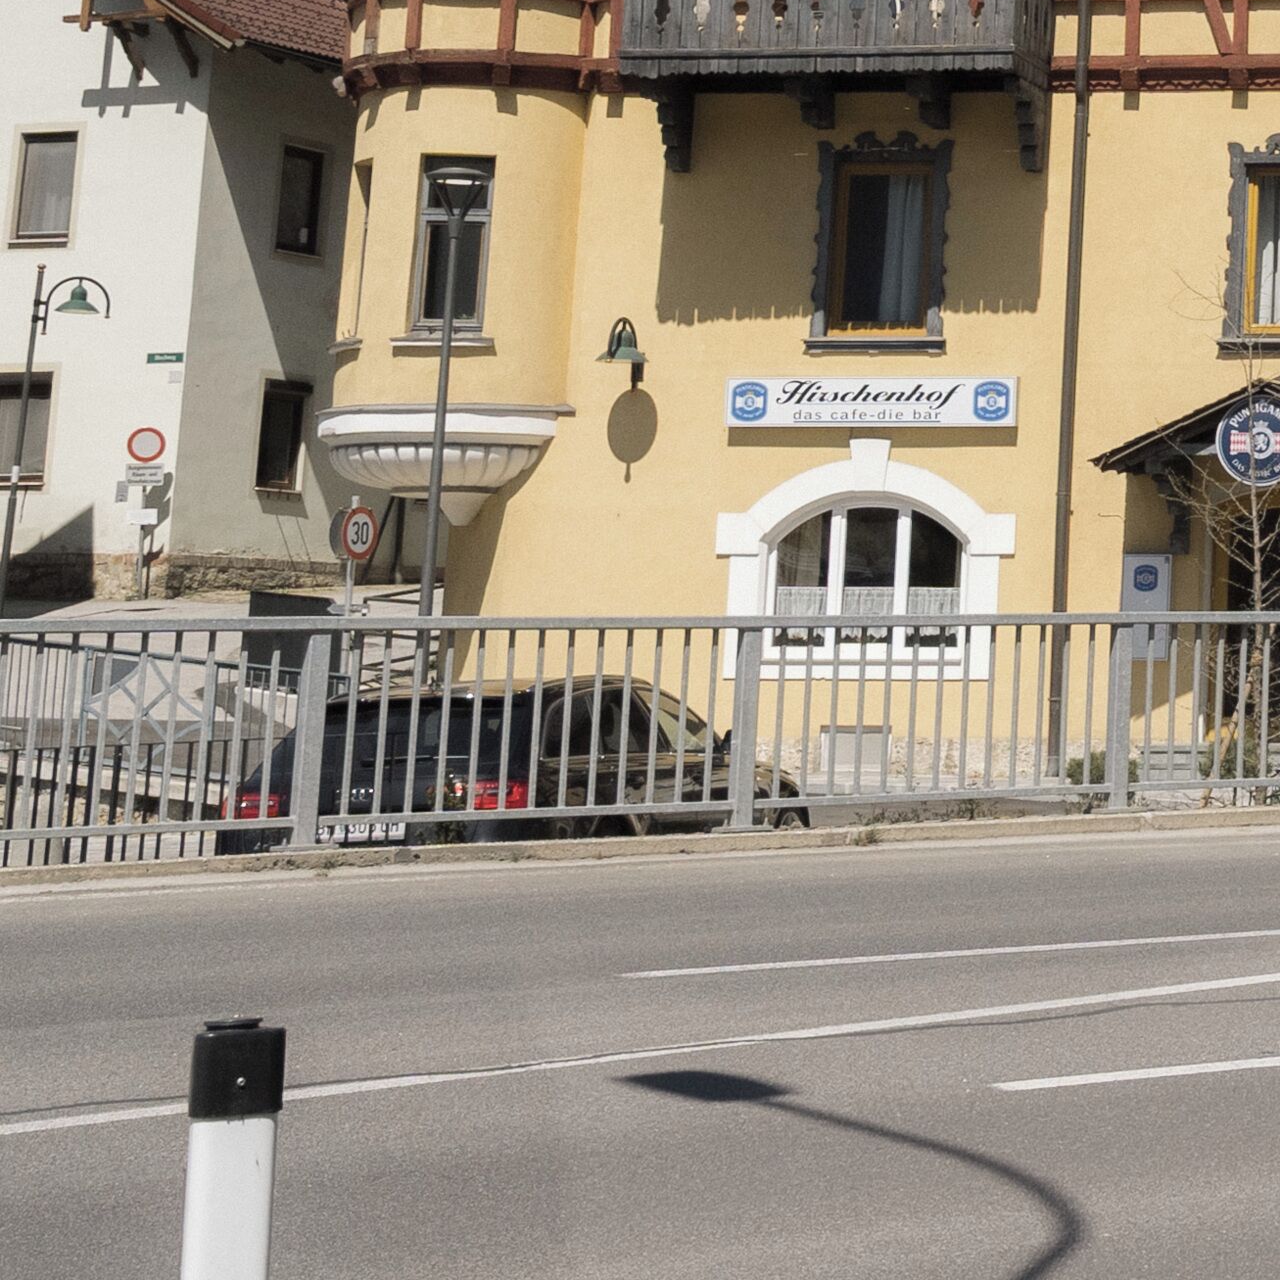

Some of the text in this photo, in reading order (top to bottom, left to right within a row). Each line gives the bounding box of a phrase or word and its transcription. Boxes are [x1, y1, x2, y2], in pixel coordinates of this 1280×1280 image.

[776, 380, 966, 411] Hirschenhof
[792, 409, 822, 420] das
[913, 409, 942, 420] bar
[351, 521, 370, 546] 30
